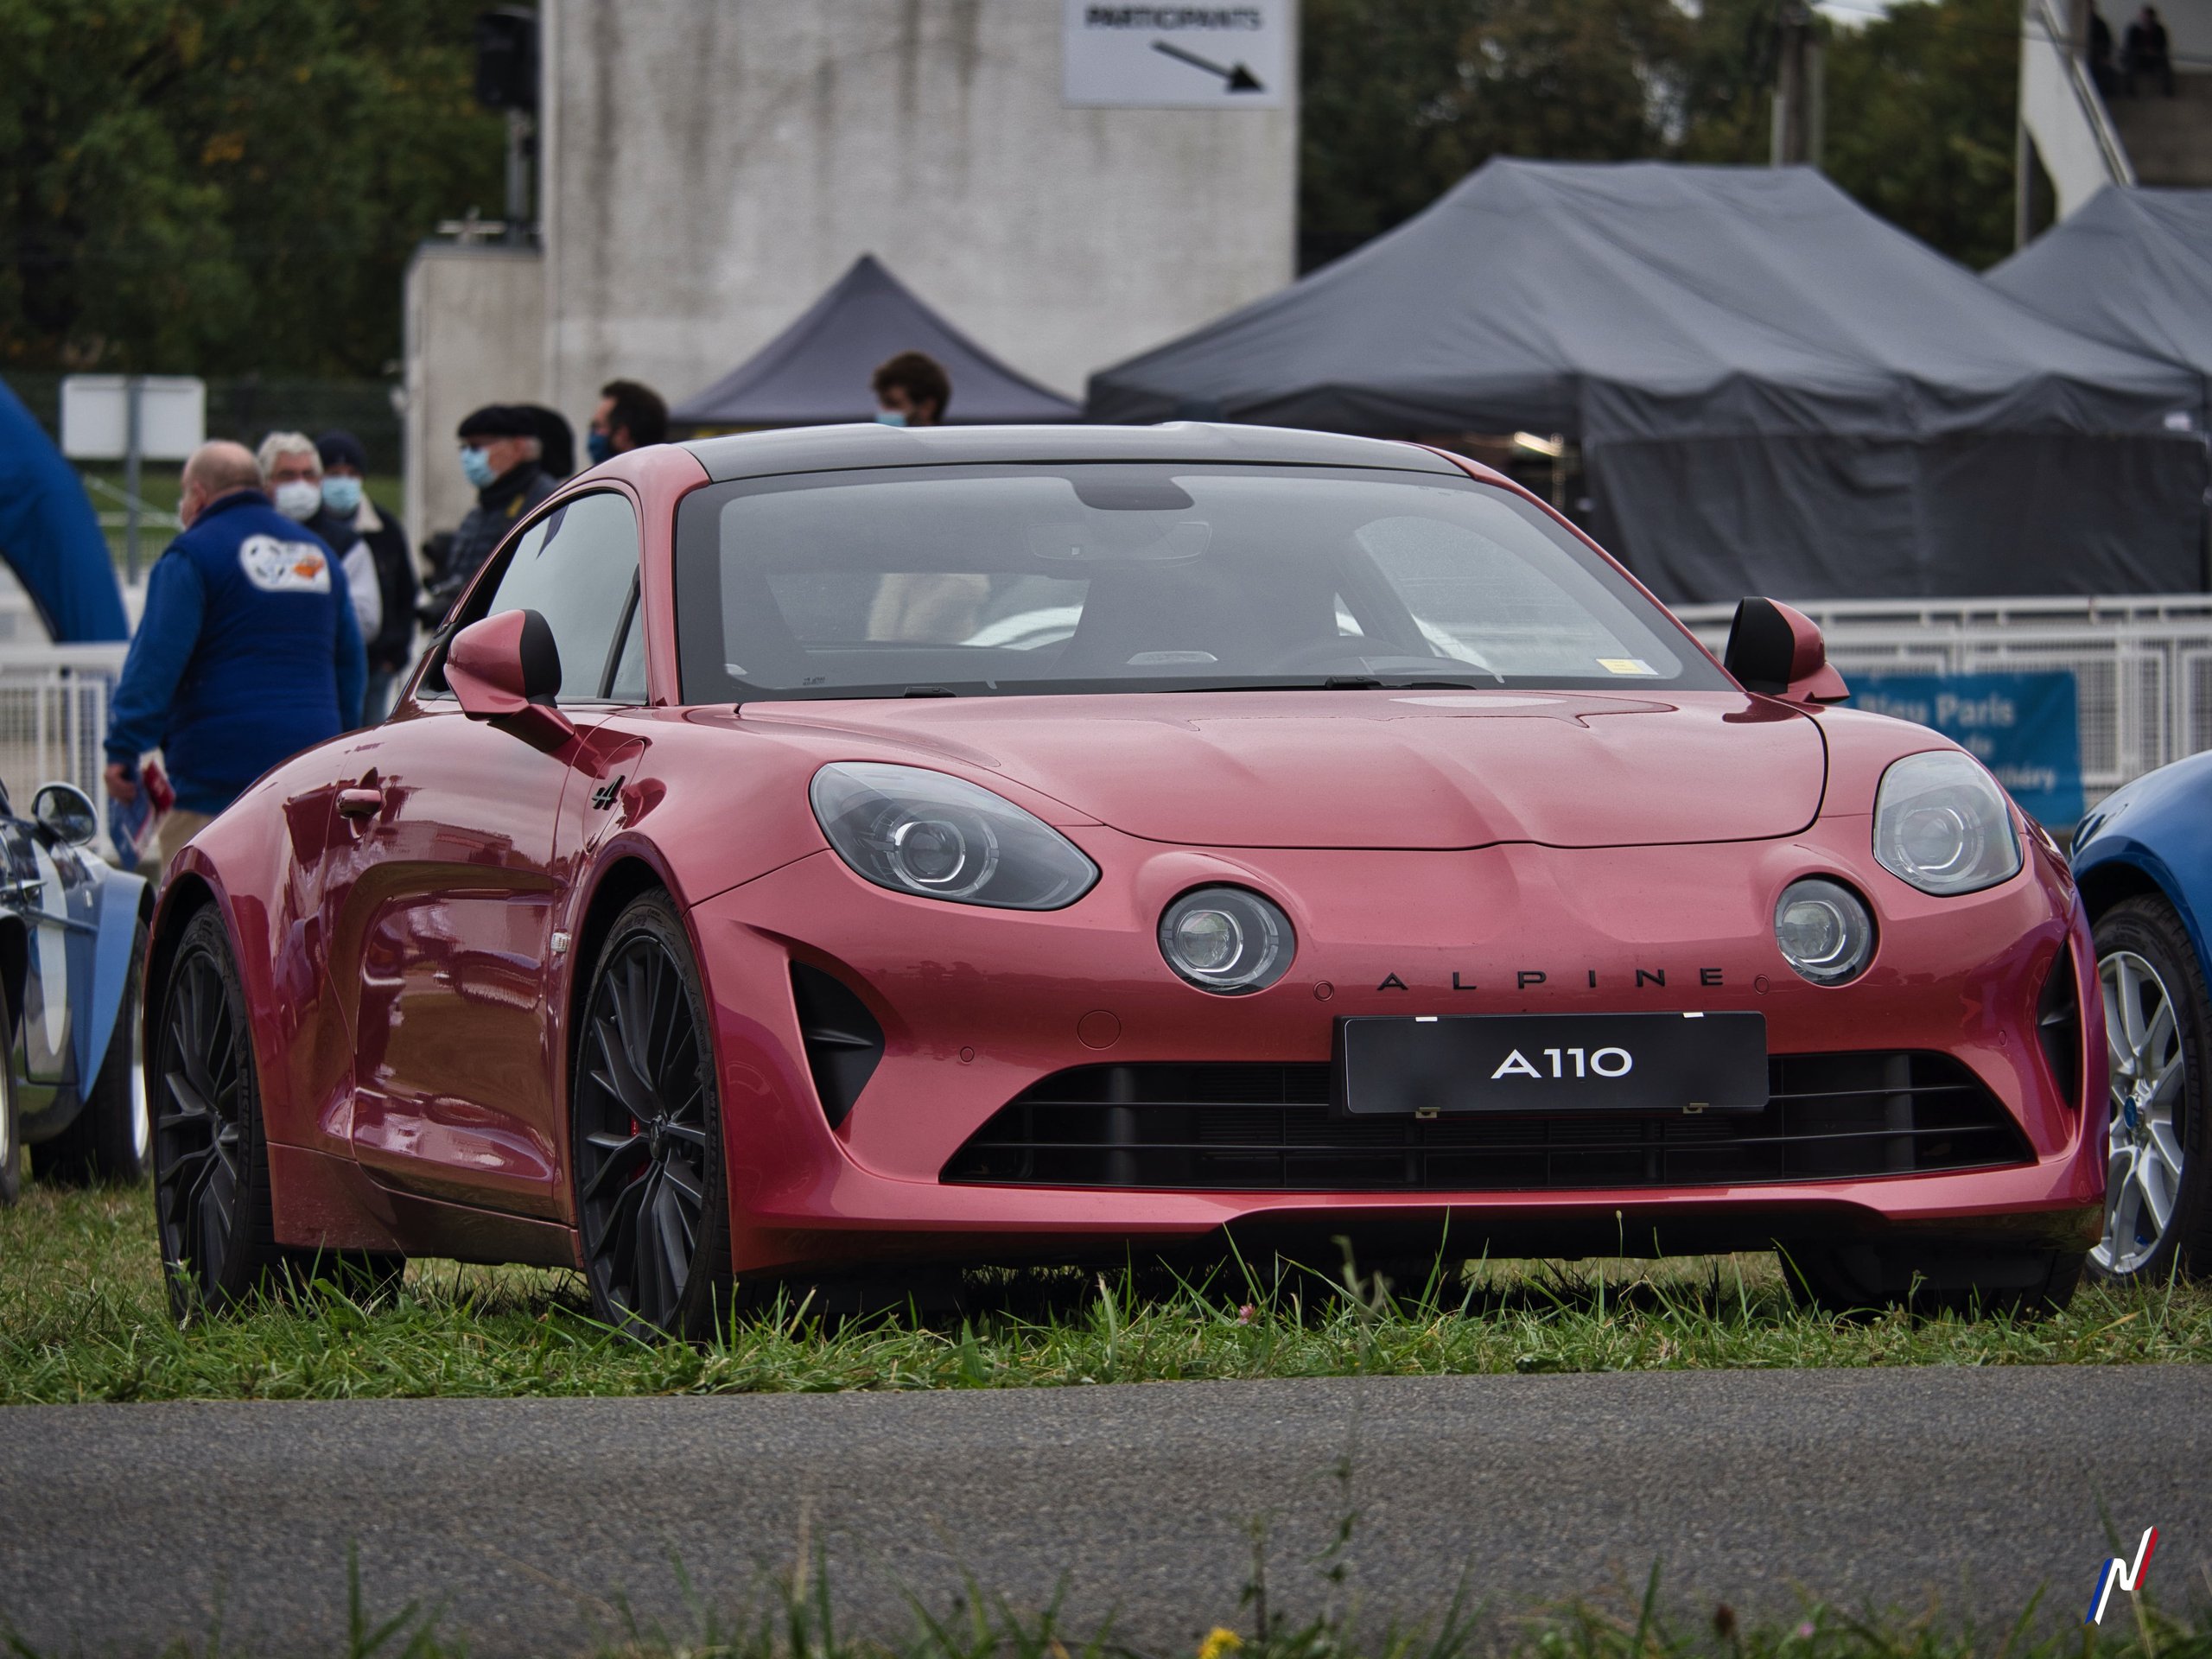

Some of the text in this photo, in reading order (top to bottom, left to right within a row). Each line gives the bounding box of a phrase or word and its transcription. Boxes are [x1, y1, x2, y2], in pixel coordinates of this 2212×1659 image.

[1936, 693, 2015, 726] Paris
[1376, 968, 1724, 992] ALPINE
[1491, 1047, 1633, 1079] A110
[708, 1090, 718, 1202] MICHELIN
